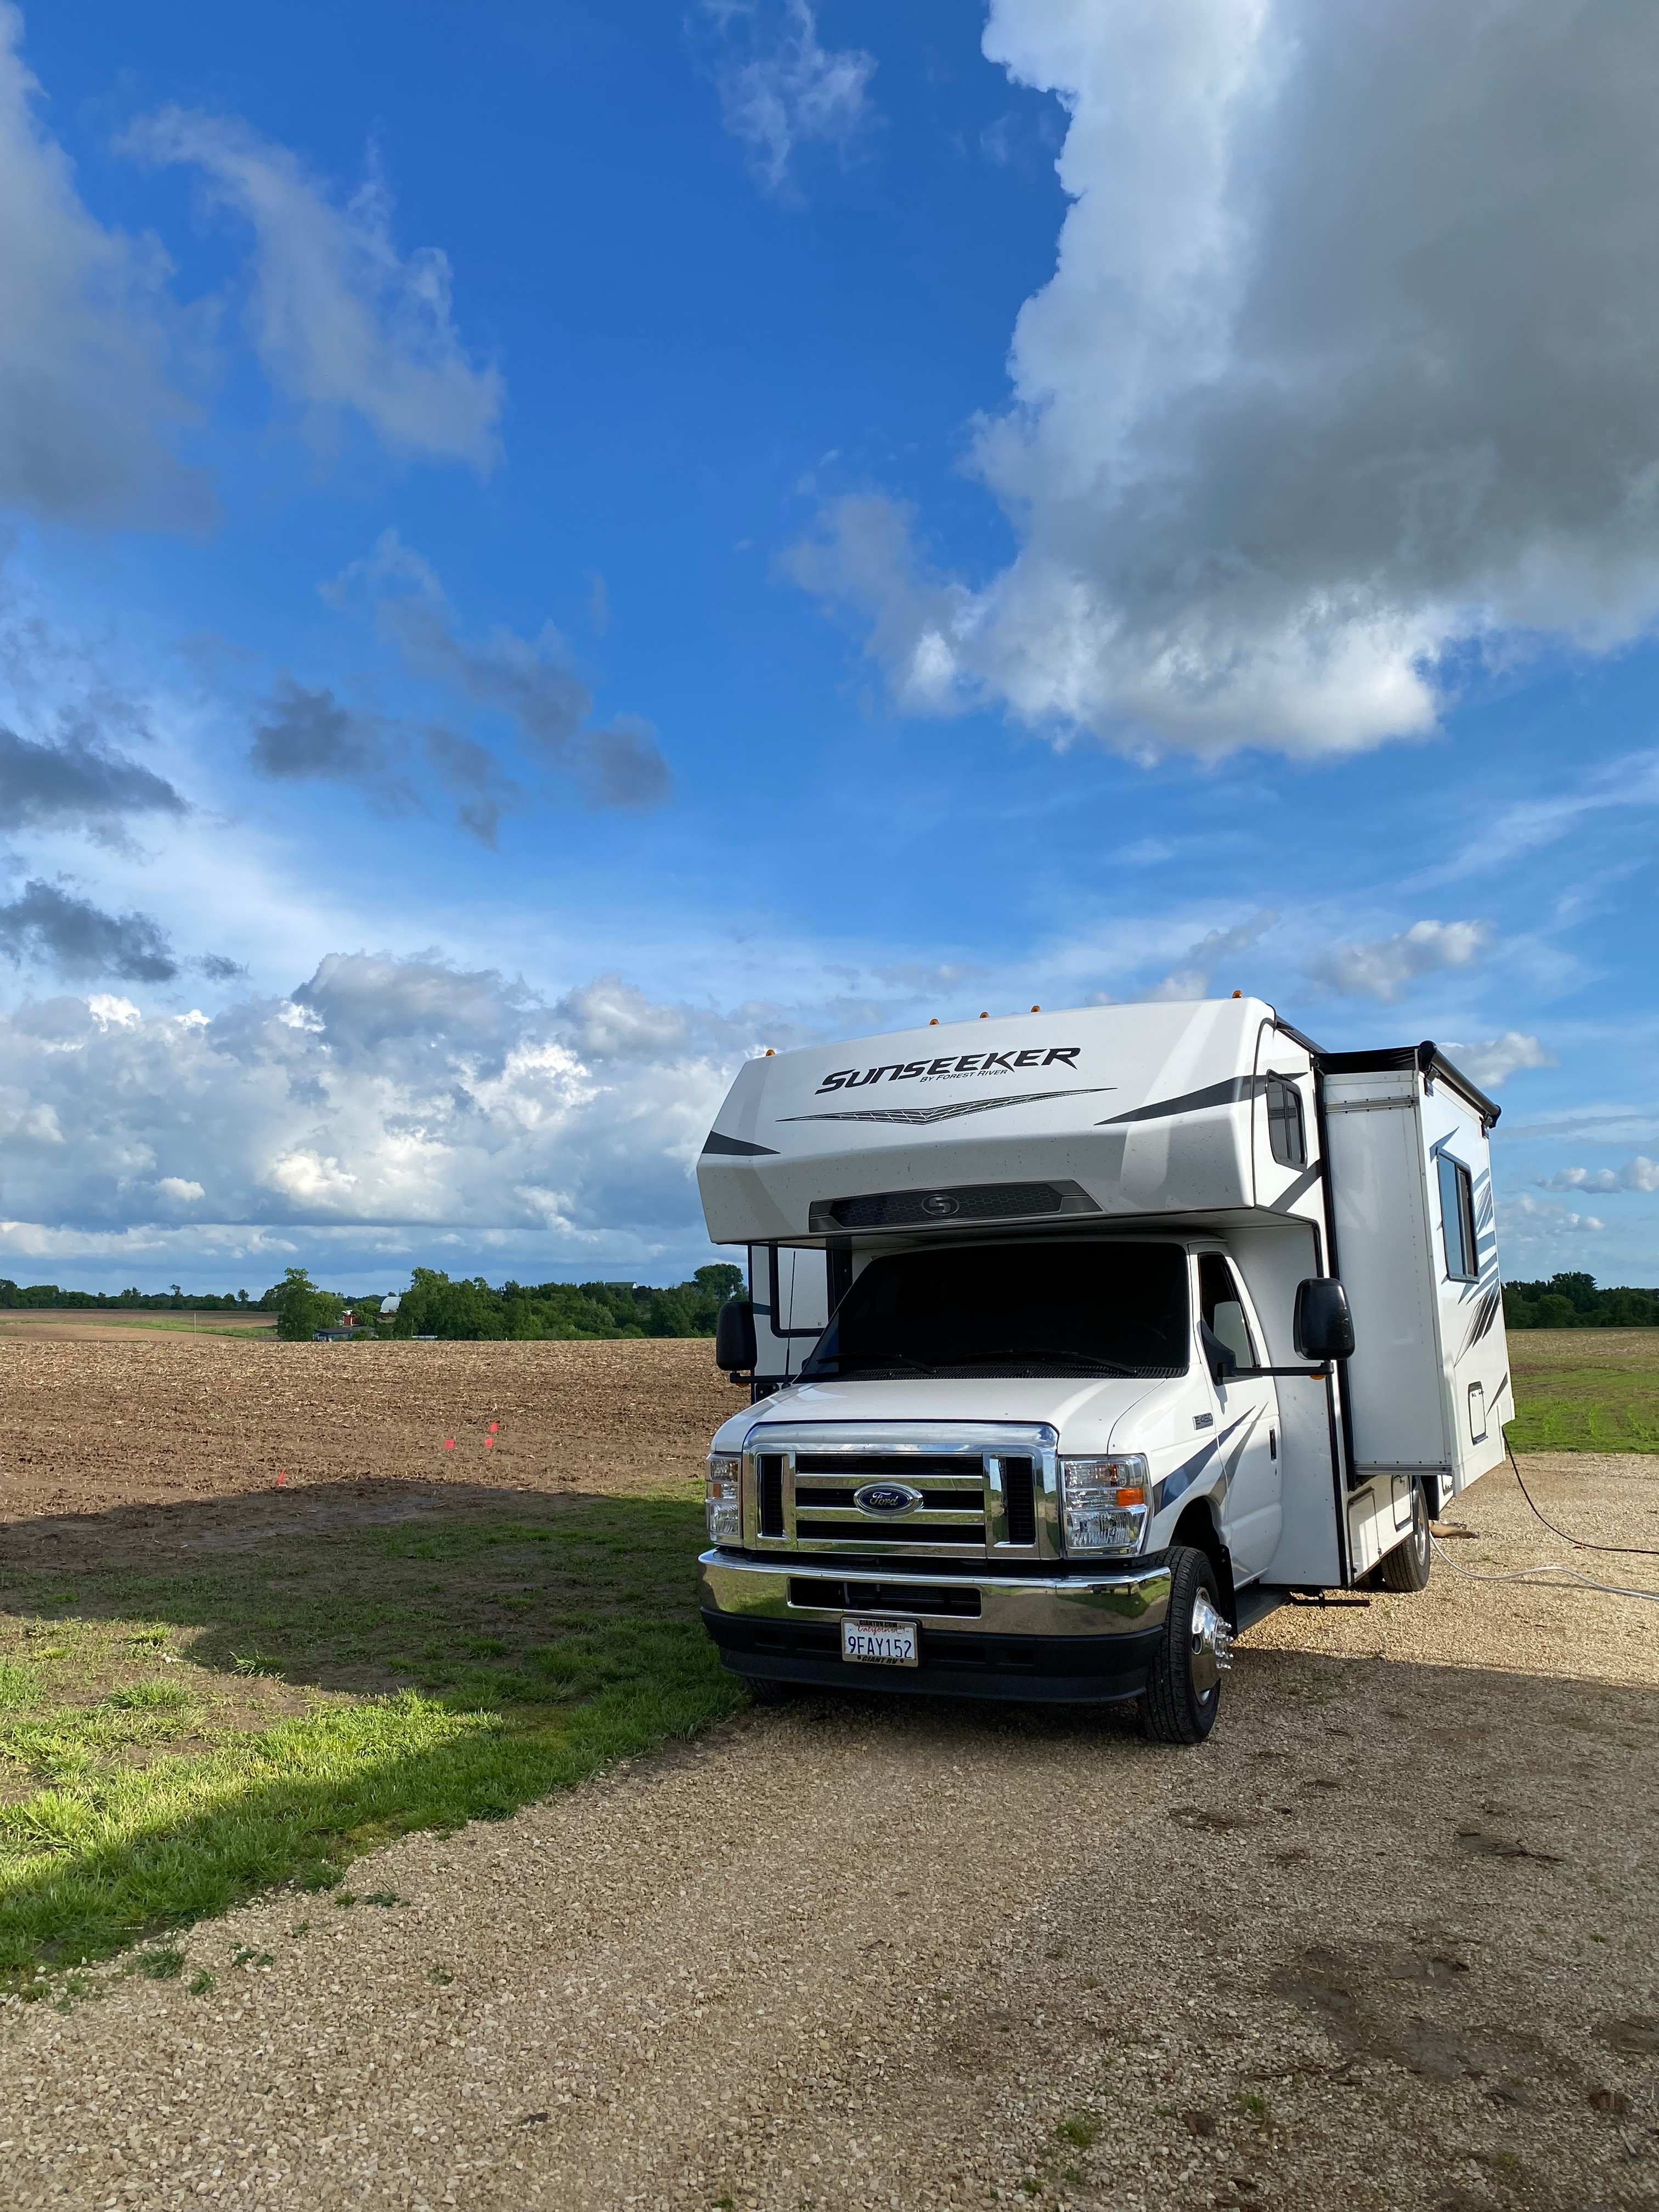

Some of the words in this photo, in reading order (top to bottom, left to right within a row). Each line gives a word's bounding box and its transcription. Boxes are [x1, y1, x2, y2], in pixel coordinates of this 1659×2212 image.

[815, 1047, 1081, 1094] SUNSEEKER
[935, 1072, 975, 1081] FOREST
[870, 1492, 899, 1506] Ford
[857, 1626, 896, 1635] California
[848, 1636, 912, 1658] 9FAY152
